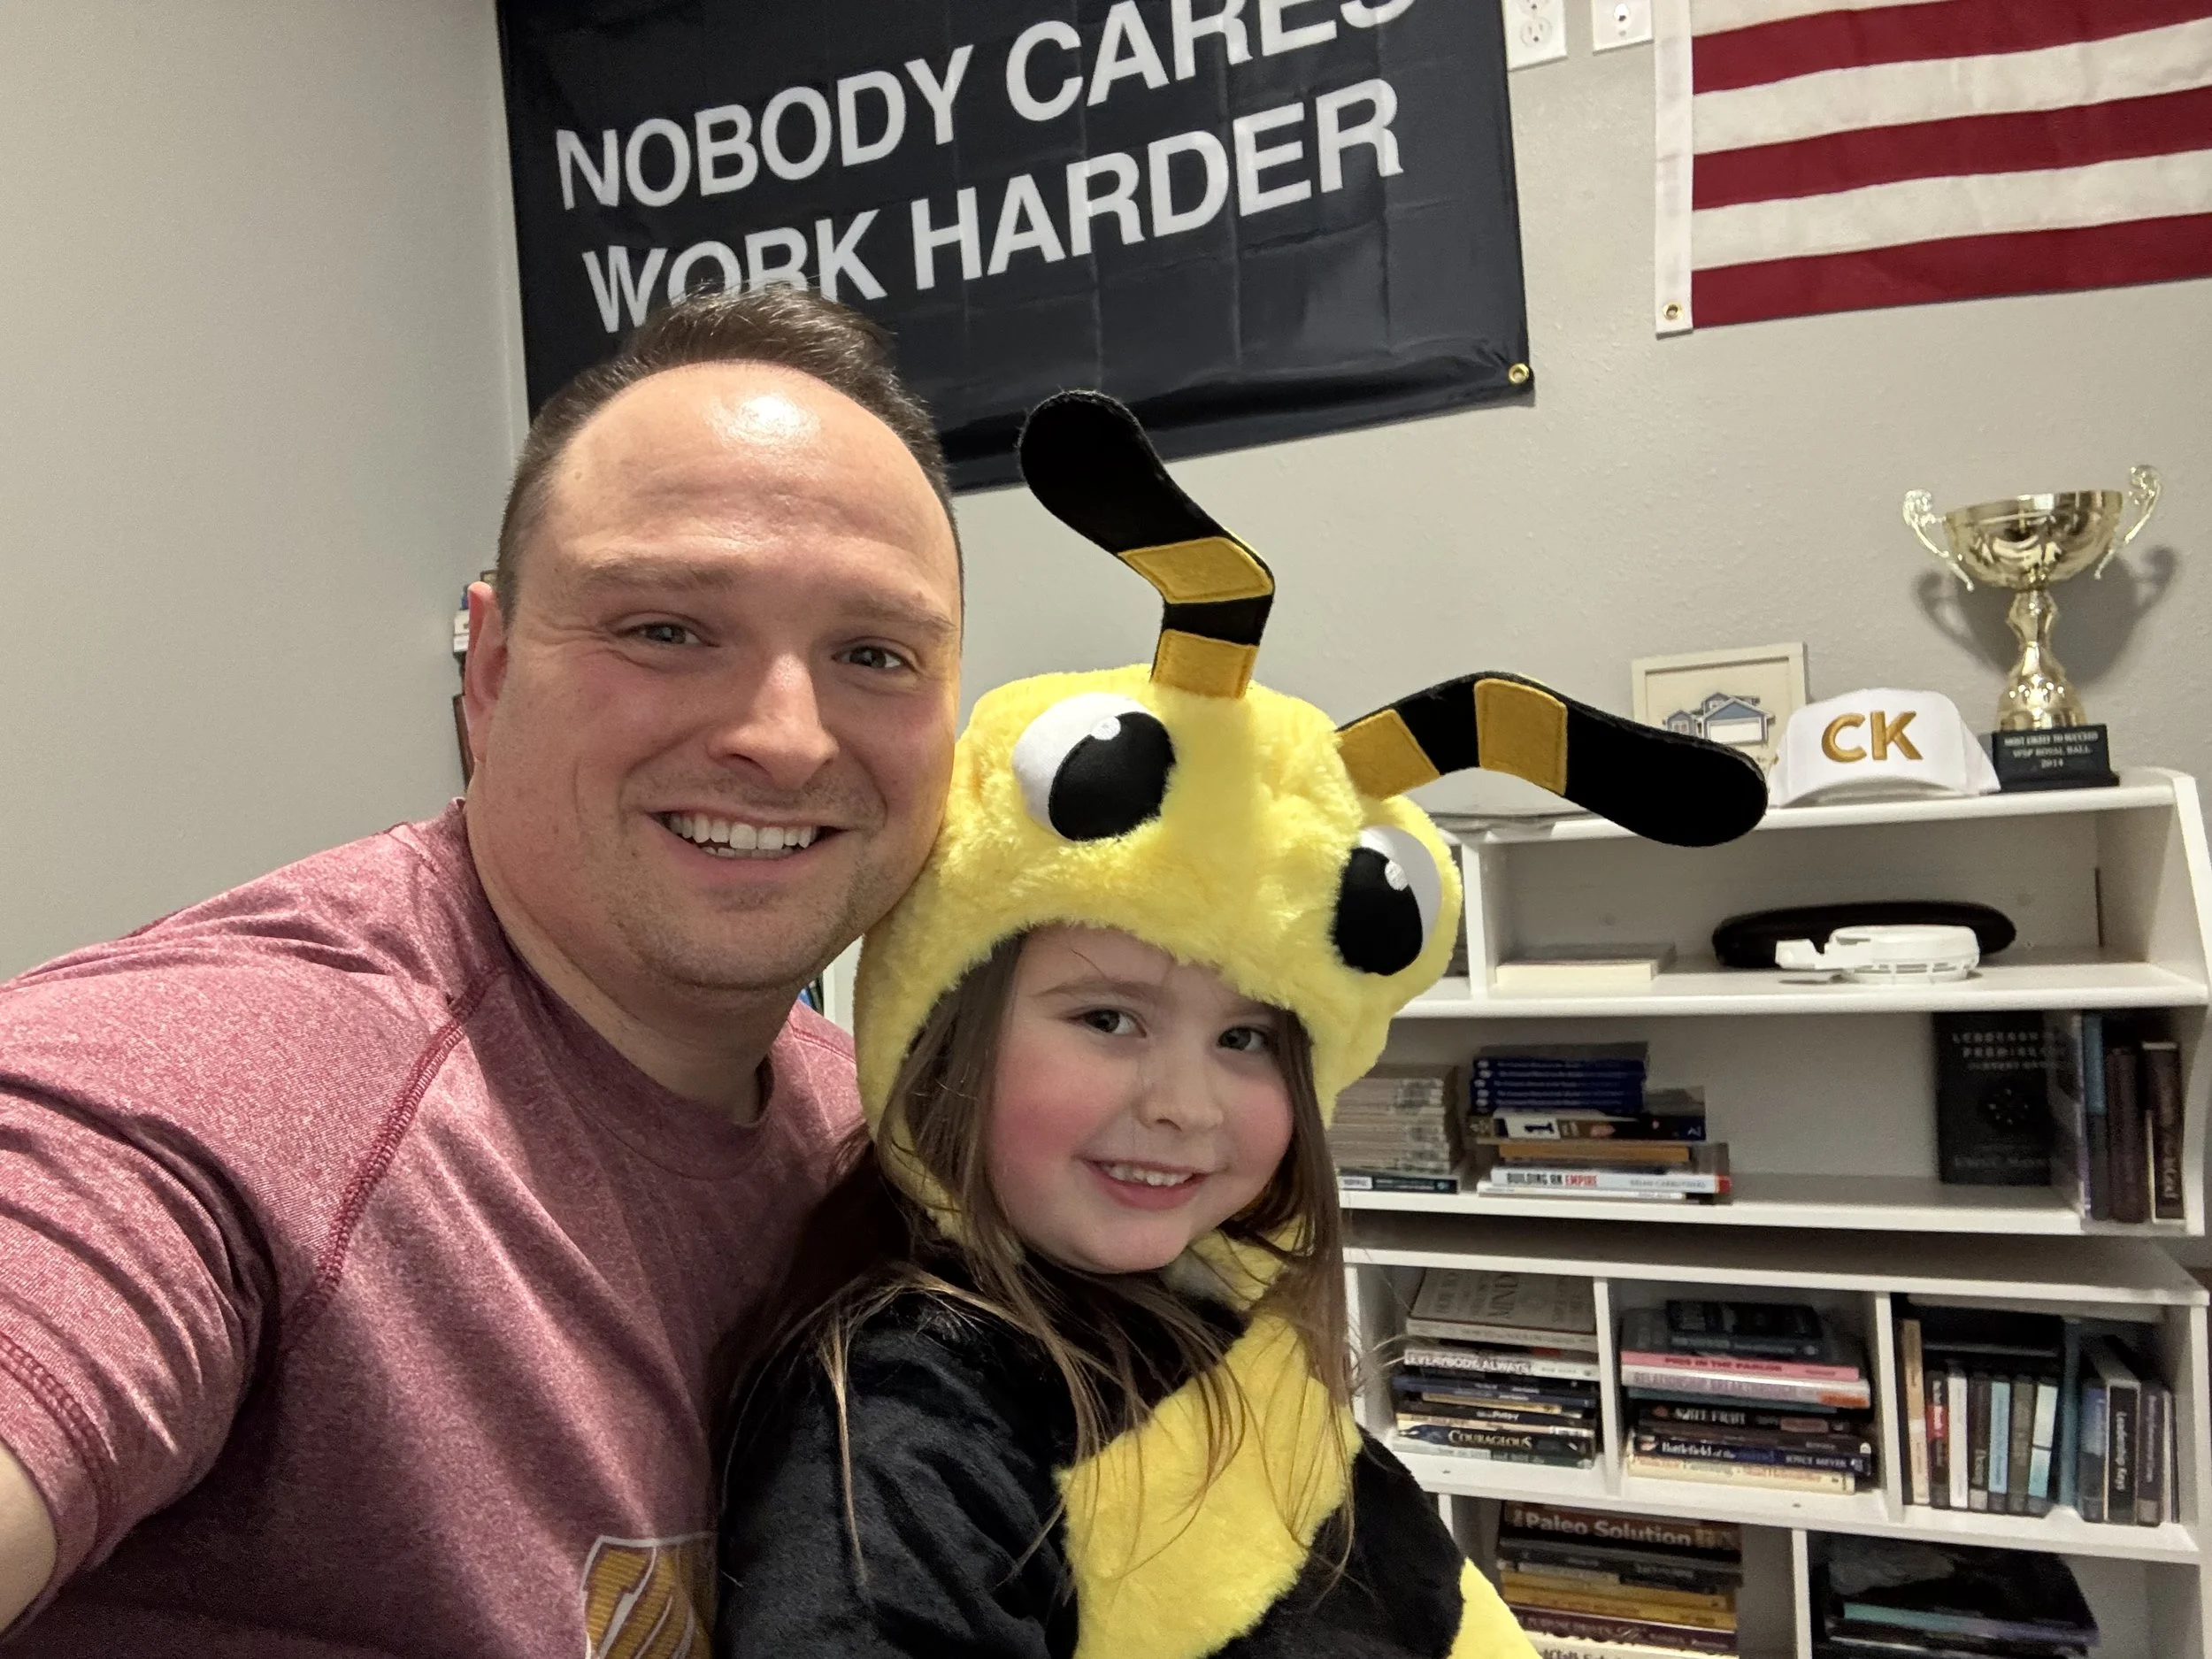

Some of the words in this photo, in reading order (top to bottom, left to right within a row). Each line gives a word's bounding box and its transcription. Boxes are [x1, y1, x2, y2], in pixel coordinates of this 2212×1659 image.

[556, 44, 974, 210] NOBODY
[1006, 0, 1417, 122] CARE
[581, 209, 887, 333] WORK
[910, 79, 1403, 289] HARDER
[1821, 710, 1924, 763] CK
[1507, 1172, 1548, 1186] BUILDING
[1565, 1174, 1599, 1187] EMPIRE
[1711, 1360, 1732, 1369] THE
[1525, 1512, 1588, 1535] Paleo
[1594, 1520, 1692, 1547] Solution
